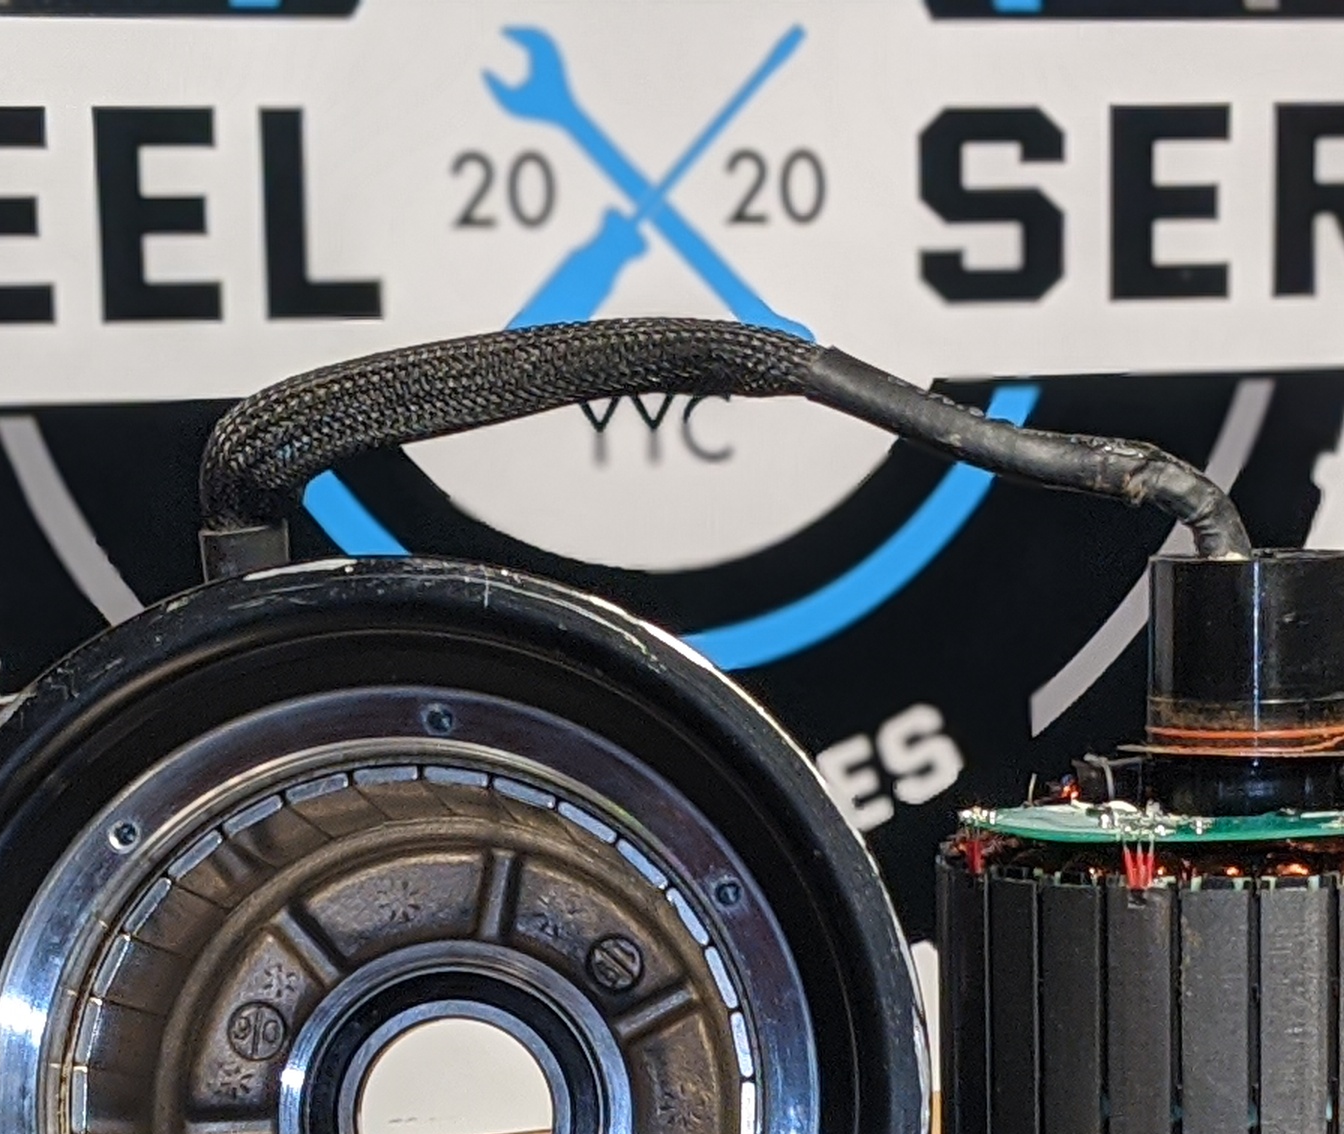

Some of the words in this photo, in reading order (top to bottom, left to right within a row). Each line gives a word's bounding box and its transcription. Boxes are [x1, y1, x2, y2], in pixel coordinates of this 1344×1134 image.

[450, 149, 557, 229] 20
[725, 147, 828, 225] 20
[578, 392, 735, 464] YYC
